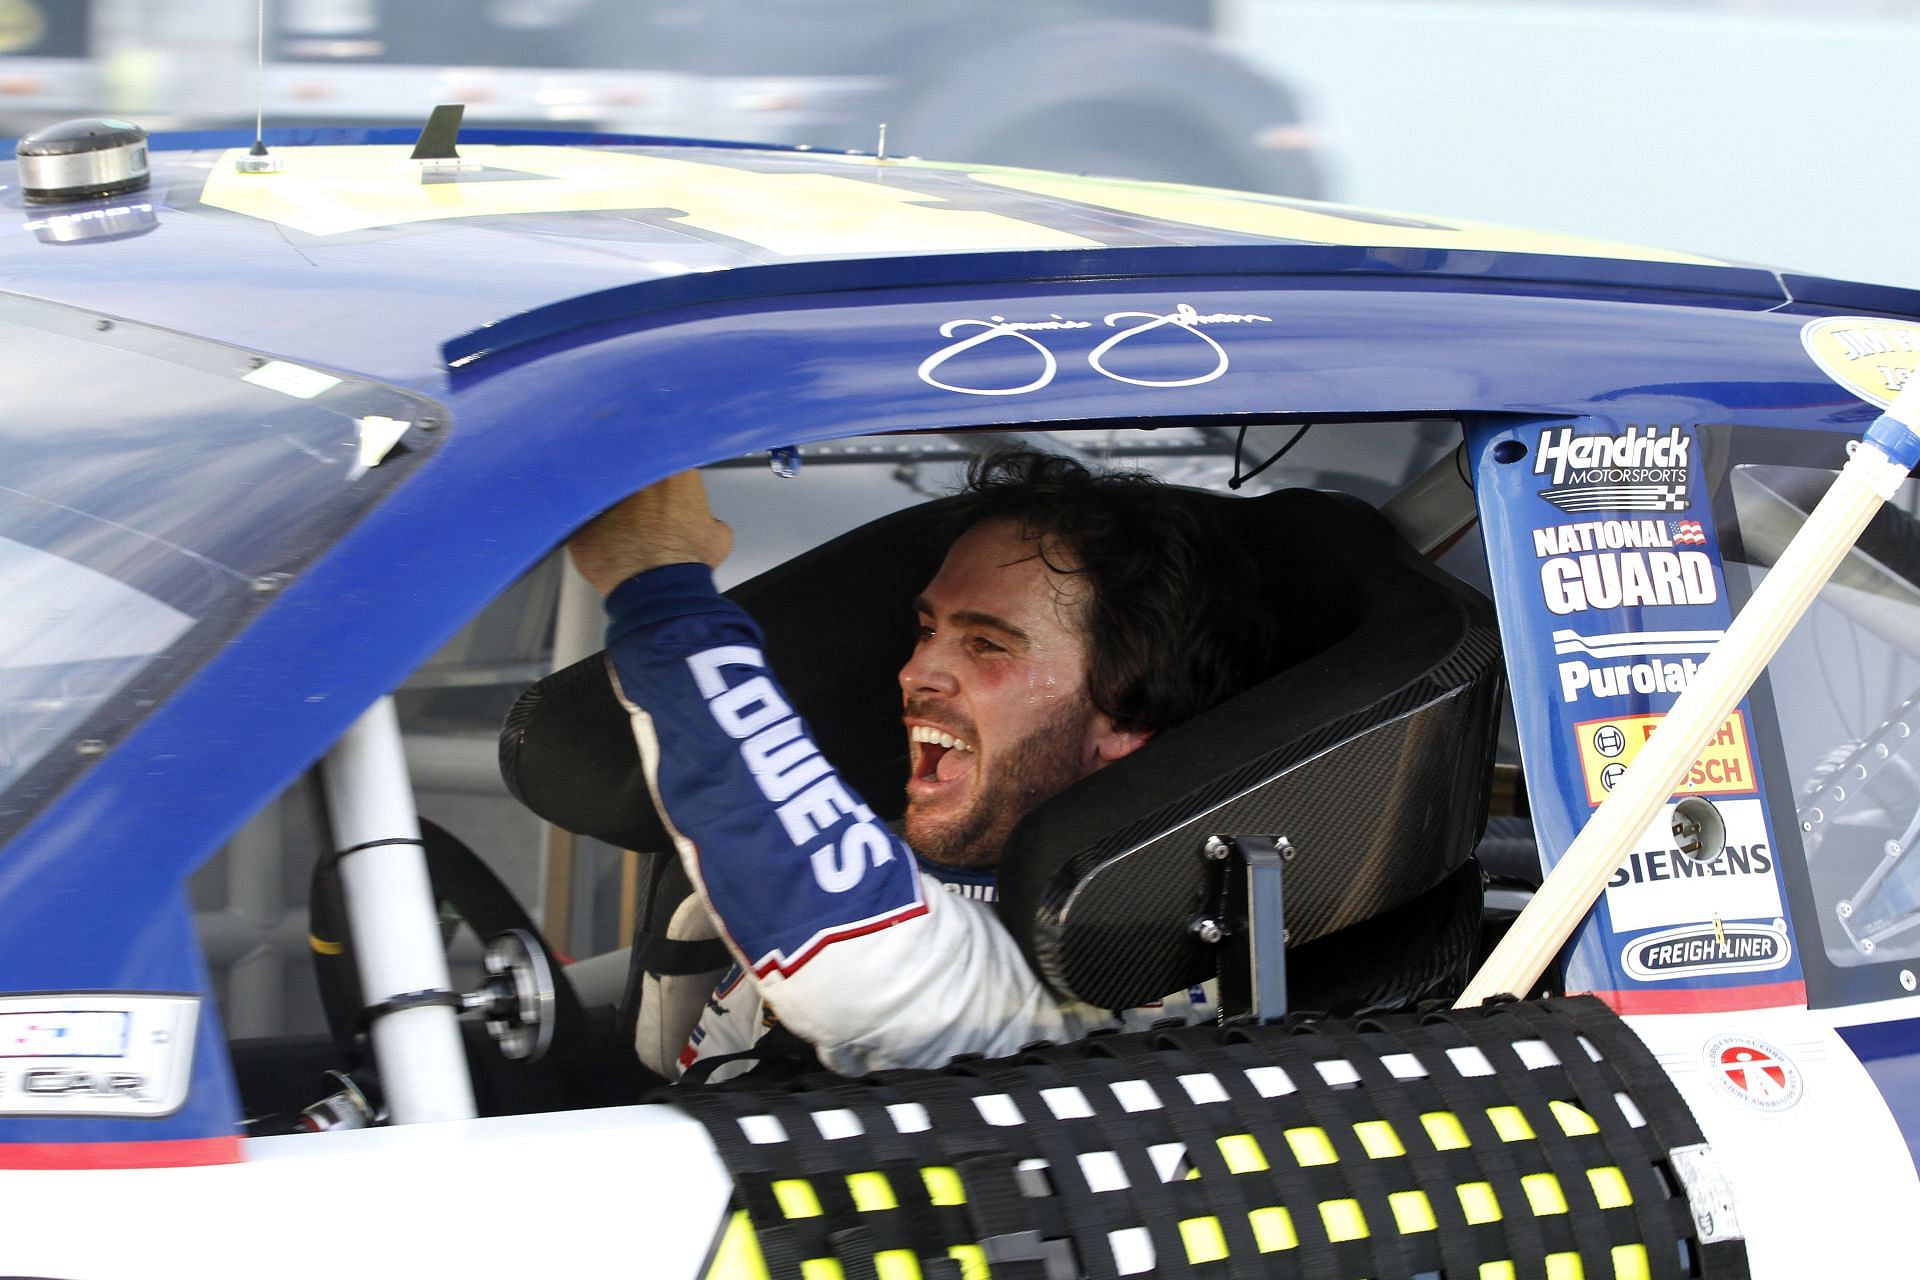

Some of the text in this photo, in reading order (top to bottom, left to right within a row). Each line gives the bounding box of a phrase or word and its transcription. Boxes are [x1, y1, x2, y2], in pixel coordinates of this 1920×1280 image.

[1534, 427, 1690, 485] Hendrick
[1568, 468, 1686, 485] MOTORSPORTS
[1532, 519, 1672, 558] NATIONAL
[1540, 551, 1717, 615] GUARD
[1558, 657, 1705, 703] Purolat
[685, 645, 896, 893] LOWE'S
[22, 1068, 152, 1101] CAR
